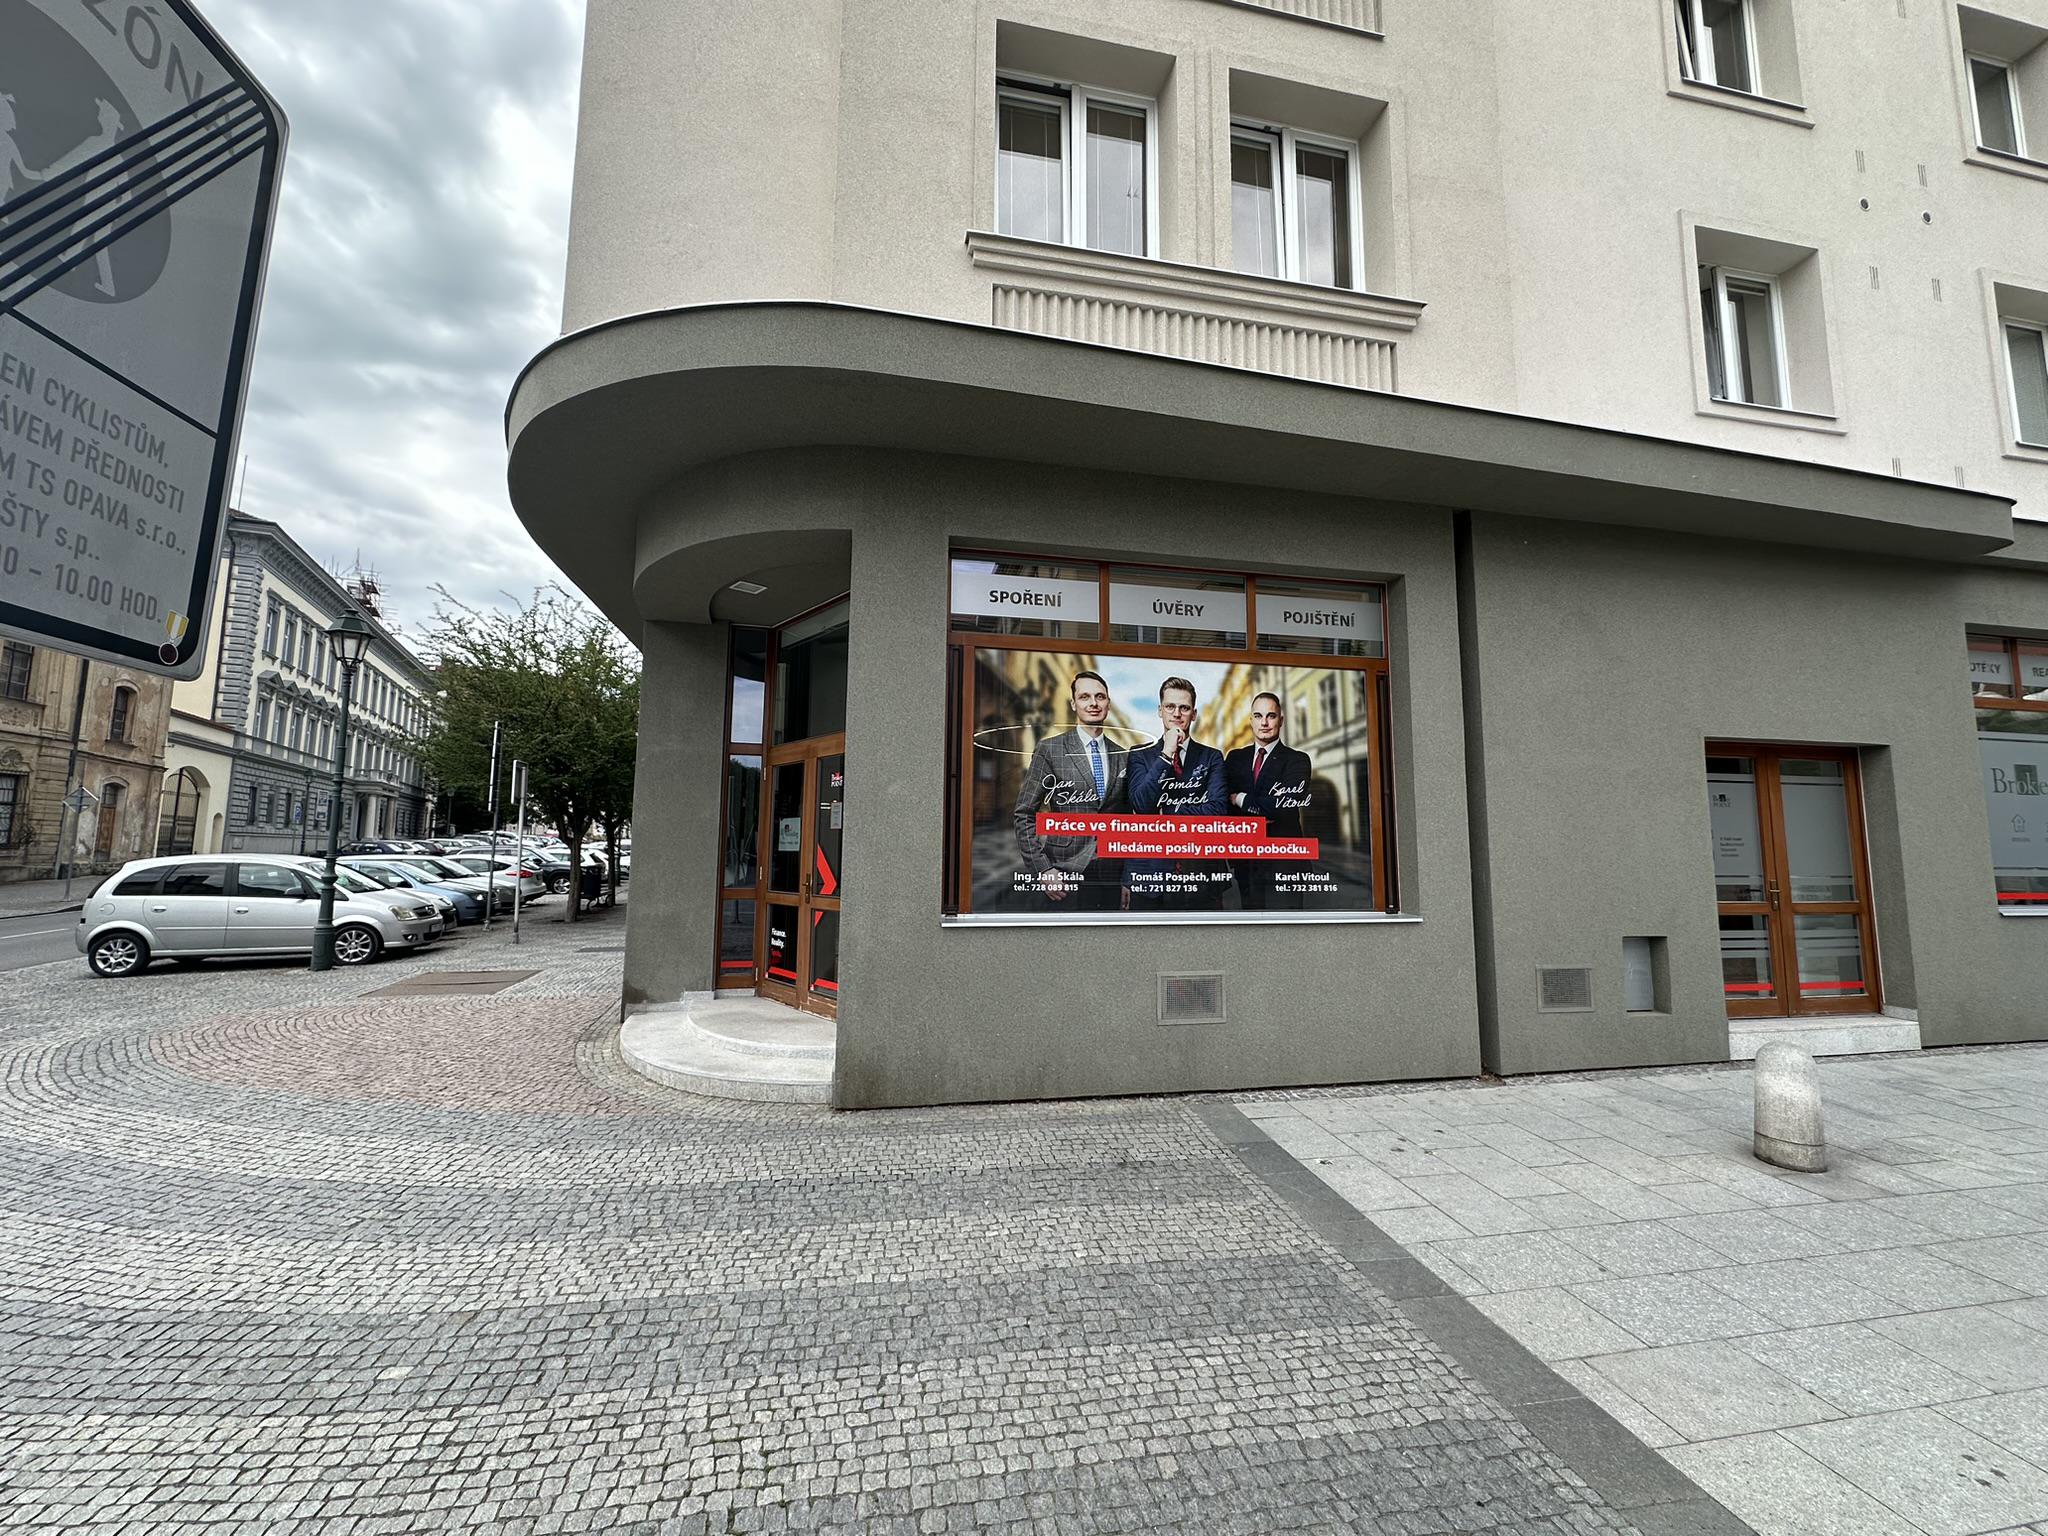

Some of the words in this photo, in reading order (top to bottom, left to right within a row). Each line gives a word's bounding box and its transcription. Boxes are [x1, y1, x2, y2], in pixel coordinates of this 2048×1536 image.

[43, 377, 169, 468] CYKLISTŮM.
[70, 436, 184, 514] PŘEDNOSTI
[26, 459, 56, 496] TS
[63, 478, 130, 530] OPAVA
[55, 563, 113, 606] 10.00
[120, 586, 161, 623] HOD.
[989, 589, 1062, 607] SPOŘENÍ
[1152, 598, 1205, 616] ÚVĚRY
[1283, 610, 1355, 627] POJIŠTĚNÍ
[1042, 774, 1075, 805] Jan
[1158, 776, 1203, 790] Tomáš
[1268, 780, 1305, 796] Karel
[1056, 789, 1099, 805] Skála
[1157, 790, 1209, 812] Pospěch
[1045, 818, 1086, 831] Práce
[1090, 821, 1107, 831] ve
[1110, 819, 1176, 833] financích
[1179, 823, 1188, 833] a
[1191, 821, 1258, 834] realitách?
[1108, 841, 1163, 853] Hledáme
[1165, 843, 1202, 855] posily
[1205, 845, 1226, 856] pro
[1228, 844, 1254, 854] tuto
[1257, 843, 1310, 856] pobočku.
[1013, 872, 1035, 883] Ing.
[1037, 872, 1055, 881] Jan
[1057, 871, 1085, 881] Skála
[1130, 871, 1163, 881] Tomáš
[1165, 872, 1210, 883] Pospěch,
[1211, 872, 1233, 881] MFP
[1275, 872, 1300, 881] Karel
[1301, 872, 1330, 881] Vitoul
[1149, 884, 1164, 892] 721
[1165, 884, 1181, 892] 827
[1183, 884, 1198, 892] 136
[1292, 884, 1307, 892] 732
